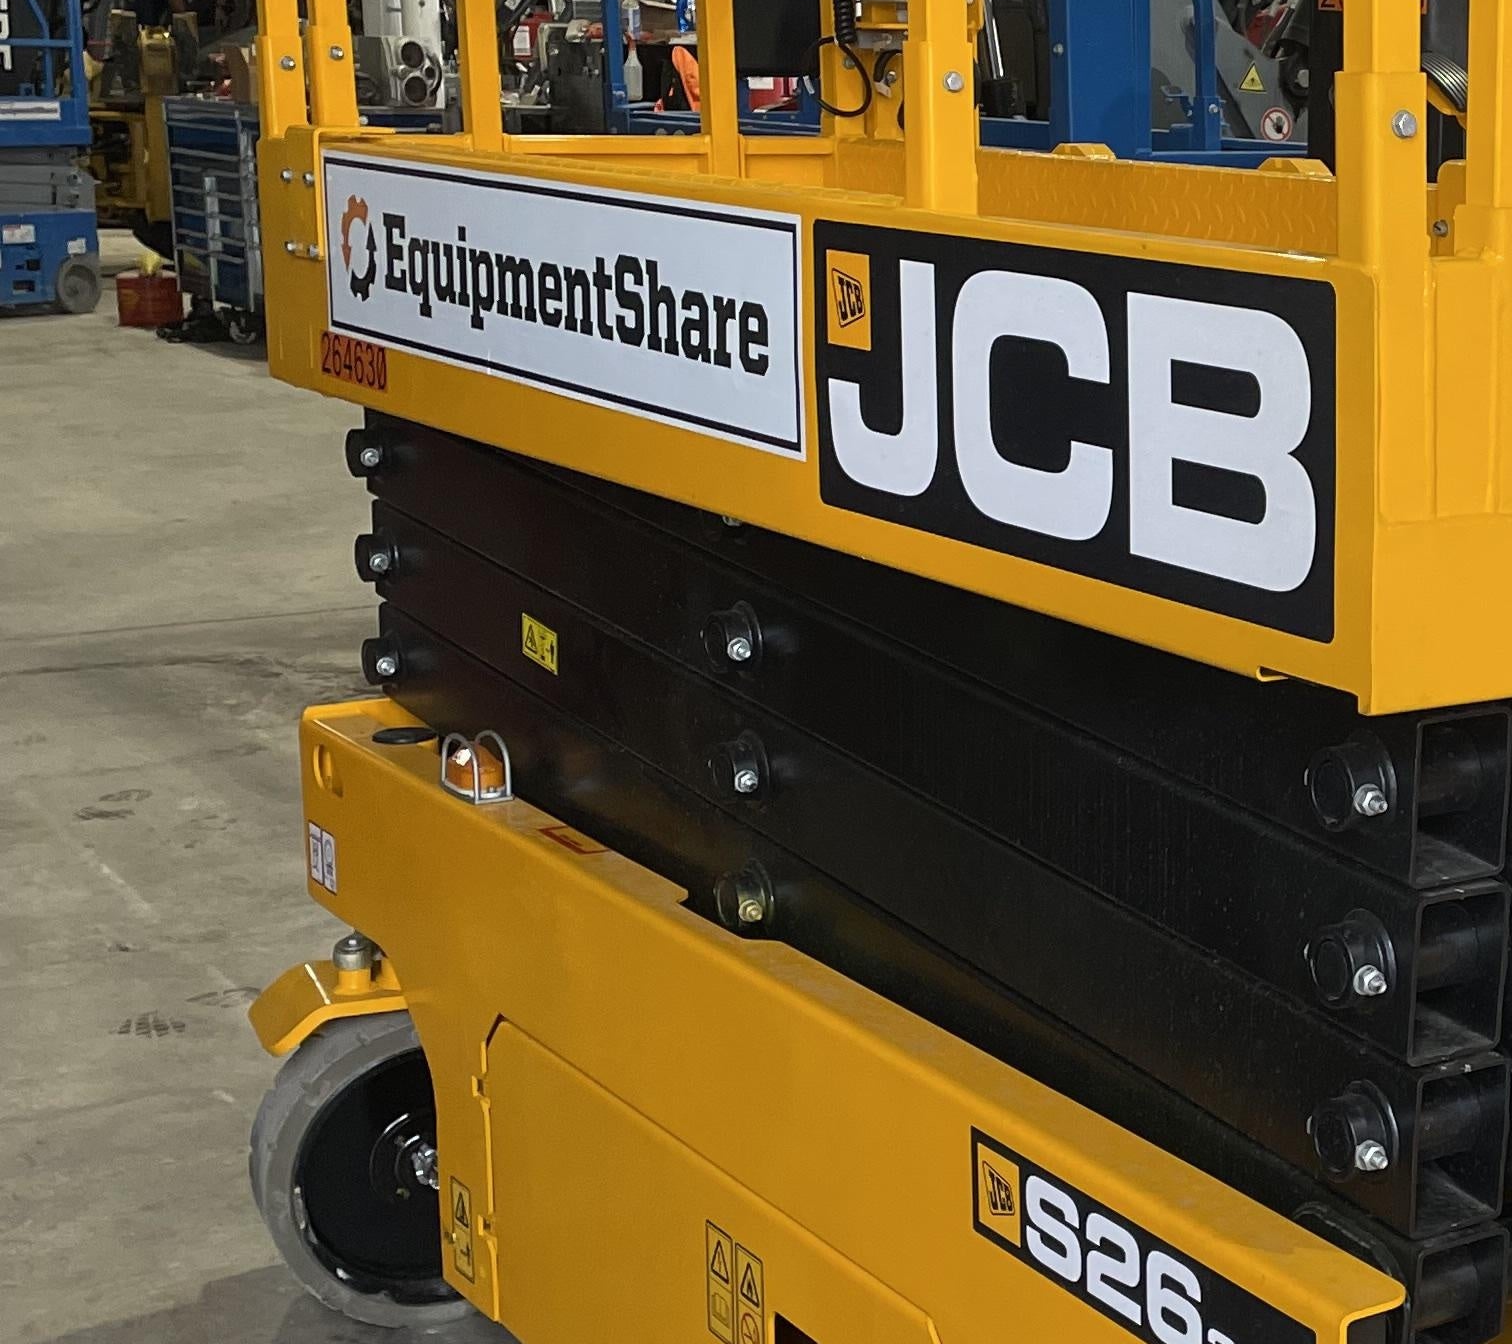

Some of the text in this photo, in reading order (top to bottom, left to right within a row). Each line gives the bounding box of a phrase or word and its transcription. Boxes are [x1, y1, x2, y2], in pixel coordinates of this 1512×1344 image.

[382, 212, 770, 377] EquipmentShare
[838, 275, 863, 322] JCB
[321, 331, 387, 390] 264630
[827, 258, 1317, 593] JCB
[988, 1168, 1014, 1213] JCB
